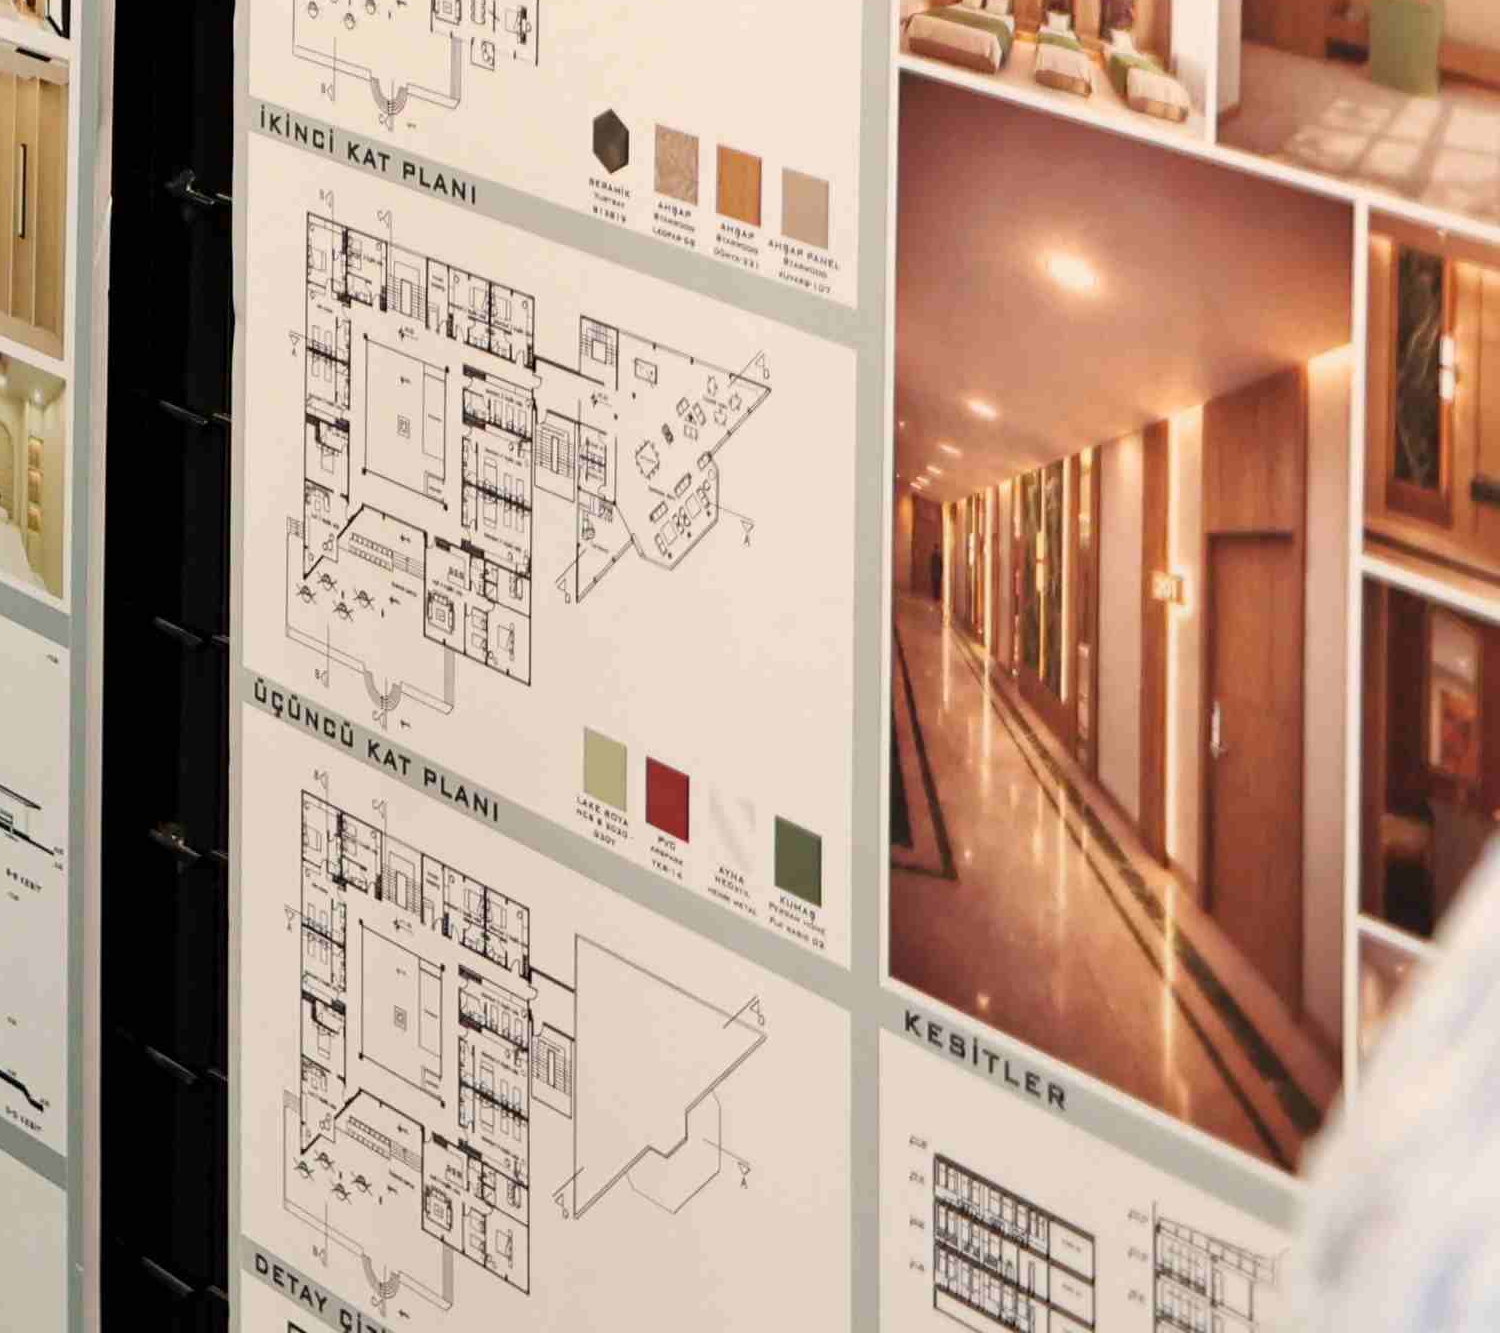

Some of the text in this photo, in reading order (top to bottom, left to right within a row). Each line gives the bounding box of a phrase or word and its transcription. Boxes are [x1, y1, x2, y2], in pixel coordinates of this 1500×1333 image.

[259, 105, 477, 206] İKİNCİ KAT PLANI
[253, 678, 500, 823] ÜÇÜNCÜ KAT PLANI
[903, 1008, 1068, 1111] KESİTLER
[255, 1252, 327, 1313] DETAY
